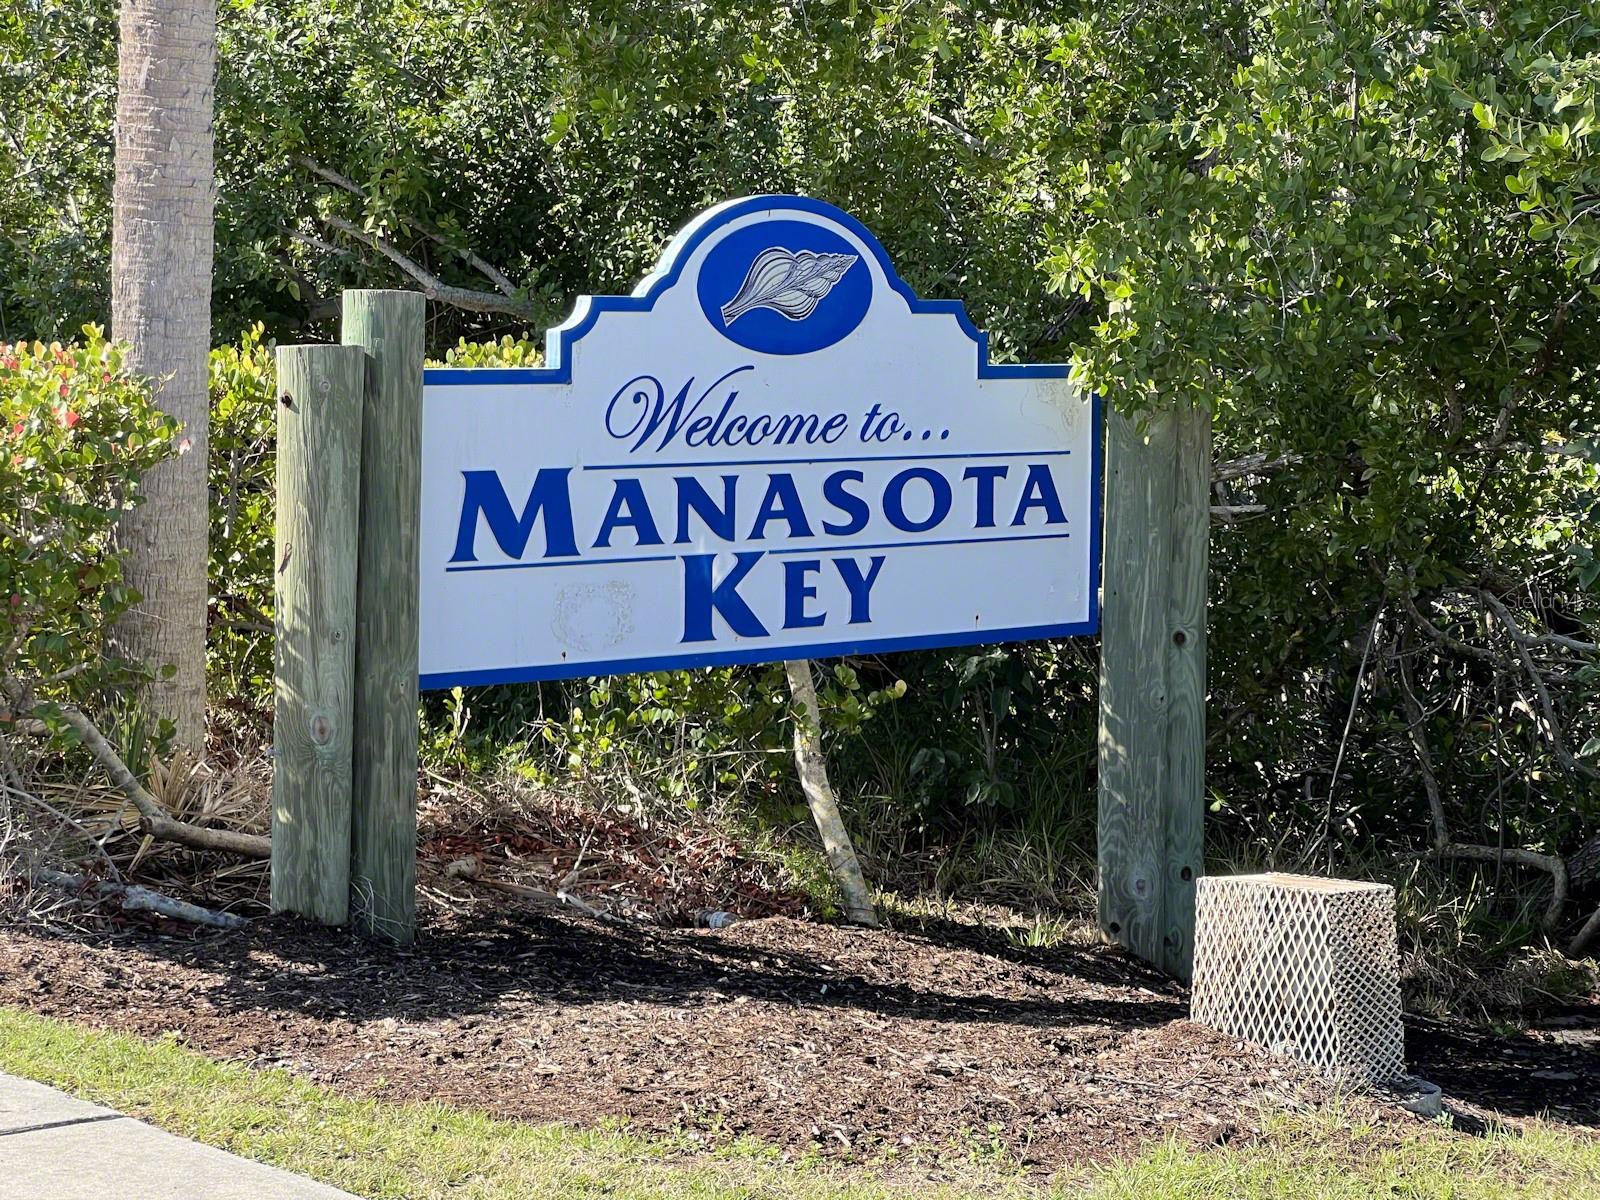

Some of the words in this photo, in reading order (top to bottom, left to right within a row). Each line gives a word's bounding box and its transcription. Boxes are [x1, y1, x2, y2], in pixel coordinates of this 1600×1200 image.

[605, 365, 848, 453] Welcome
[447, 464, 1068, 563] MANASOTA
[680, 552, 886, 642] KEY
